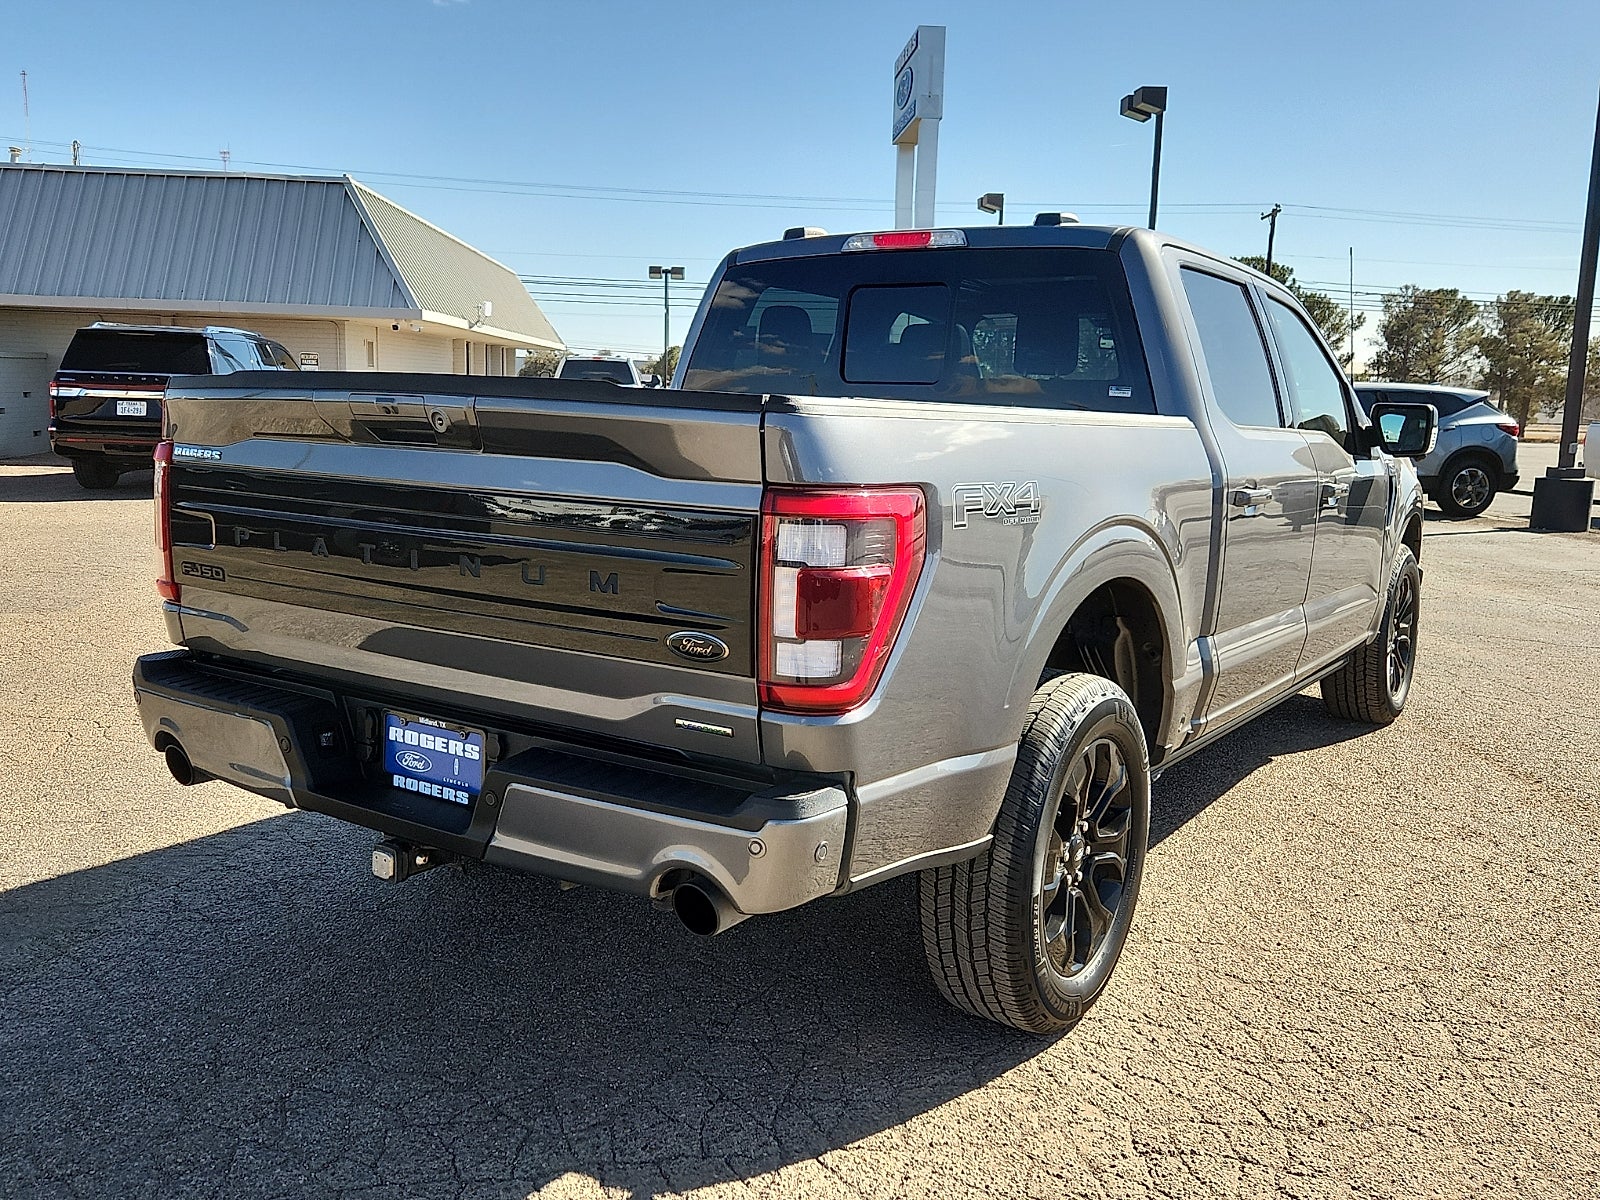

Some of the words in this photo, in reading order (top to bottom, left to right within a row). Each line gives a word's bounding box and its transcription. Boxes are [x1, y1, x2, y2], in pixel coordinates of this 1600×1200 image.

[173, 446, 223, 461] ROGERS
[952, 480, 1041, 529] FX4
[1003, 517, 1018, 525] OFF
[1020, 516, 1040, 524] ROAD
[233, 526, 619, 595] PLATINUM
[679, 636, 713, 657] Ford
[439, 721, 447, 729] TX
[388, 726, 480, 760] ROGERS
[401, 752, 425, 770] Ford
[392, 774, 470, 805] ROGERS
[442, 777, 469, 788] LINCOLN
